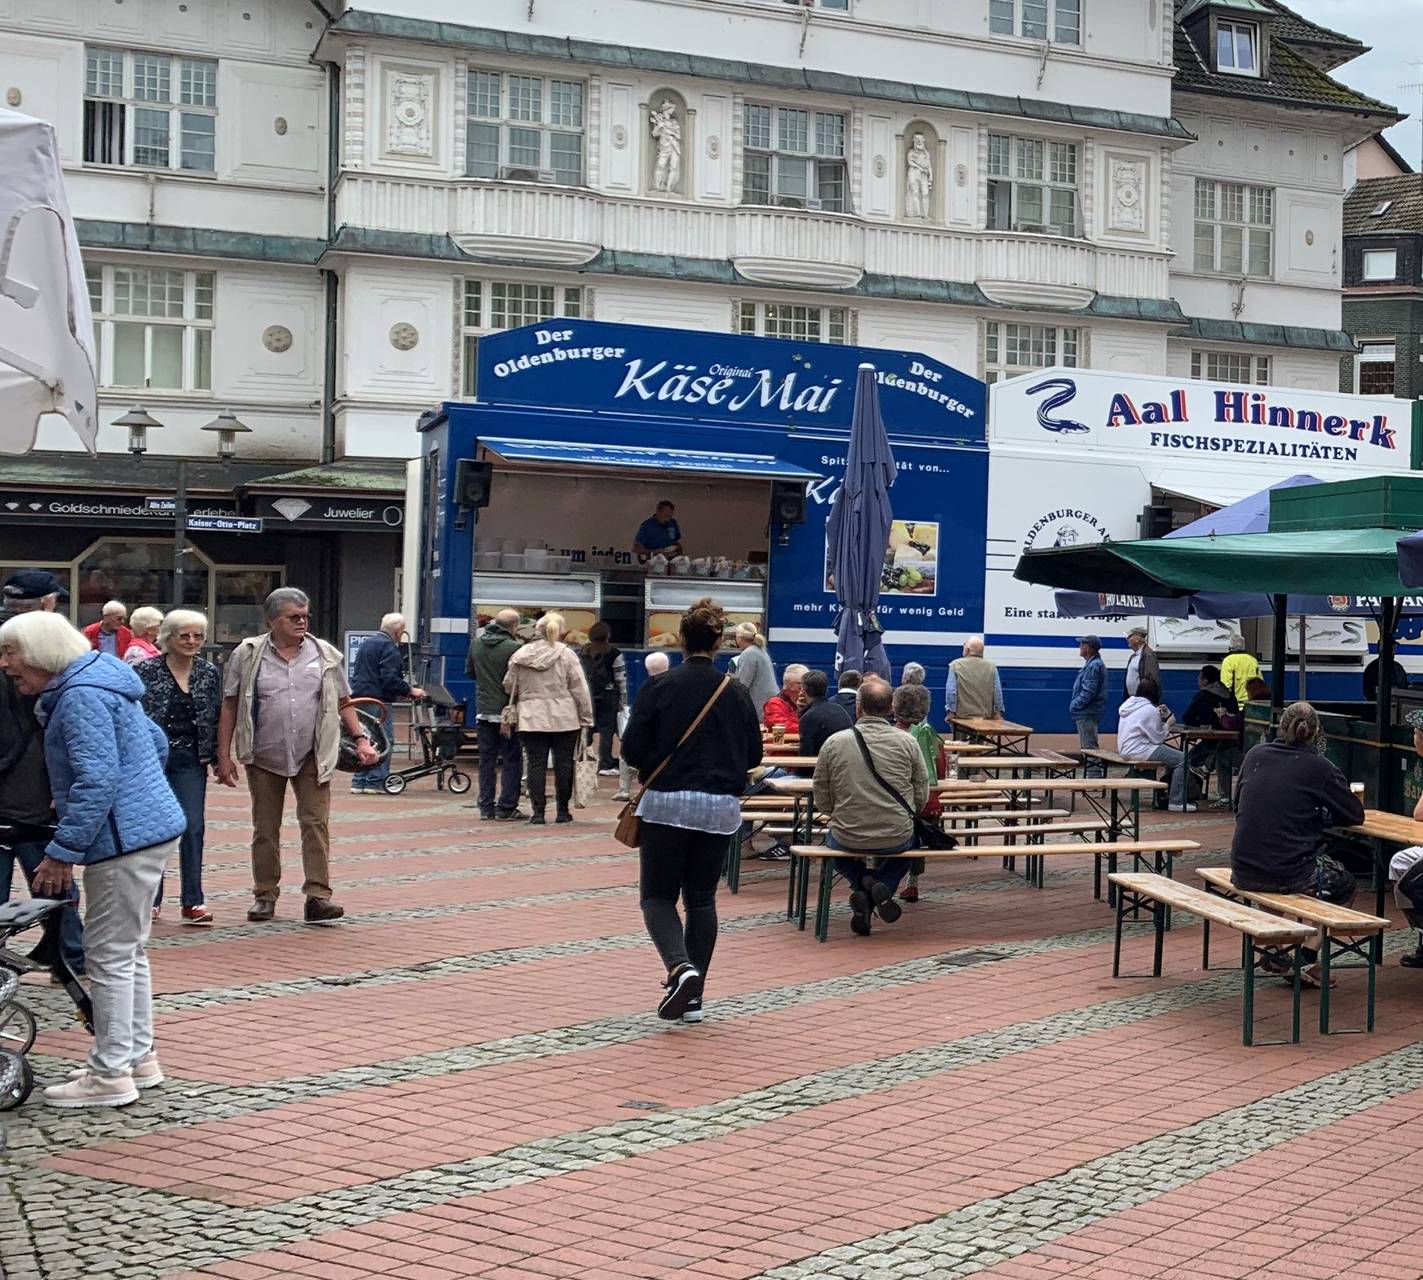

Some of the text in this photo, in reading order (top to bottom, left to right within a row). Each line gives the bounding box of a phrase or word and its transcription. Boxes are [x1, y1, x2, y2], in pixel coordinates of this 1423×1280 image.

[534, 329, 574, 345] Der
[493, 346, 625, 378] Oldenburger
[708, 364, 754, 379] Original
[909, 361, 943, 383] Der
[614, 358, 844, 413] Käse Mai
[874, 371, 975, 419] ldenburger
[1105, 389, 1398, 450] Aal Hinnerk
[1150, 431, 1359, 462] FISCHSPEZIALITÄTEN
[918, 463, 951, 474] von...
[48, 502, 176, 517] Goldschmiede
[323, 507, 375, 520] Juwelier
[188, 518, 258, 530] Kaiser-Otto-Platz
[793, 603, 824, 614] mehr
[876, 605, 894, 615] für
[899, 606, 934, 619] wenig
[938, 607, 965, 618] Geld
[1004, 607, 1033, 618] Eine
[1037, 609, 1078, 621] sta
